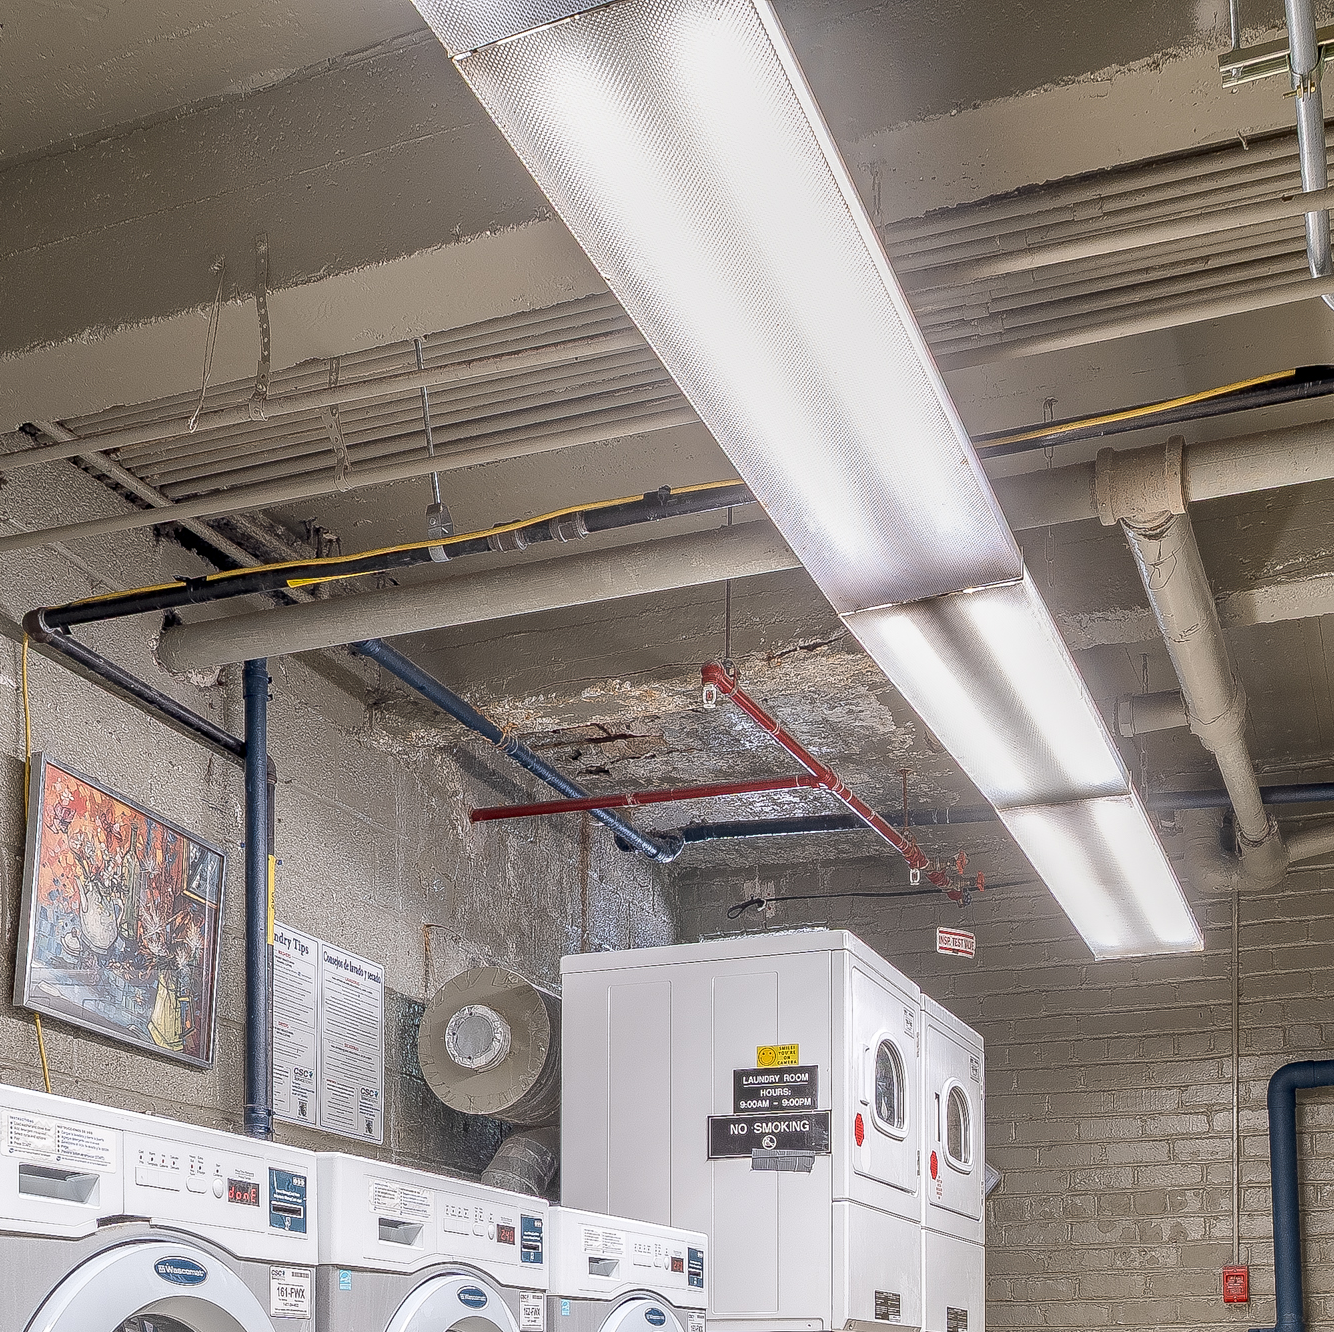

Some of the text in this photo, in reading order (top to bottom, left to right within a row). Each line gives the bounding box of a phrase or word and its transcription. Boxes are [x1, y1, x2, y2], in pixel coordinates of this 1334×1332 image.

[274, 932, 309, 956] ndry Tips
[293, 1067, 308, 1077] CSC
[743, 1073, 808, 1084] LAUNDRY ROOM
[360, 1087, 374, 1097] CSC
[760, 1088, 791, 1097] HOURS:
[740, 1098, 811, 1109] 9:00AM 9:00PM
[730, 1120, 809, 1134] NO SMOKING
[276, 1286, 306, 1299] 161-FWX
